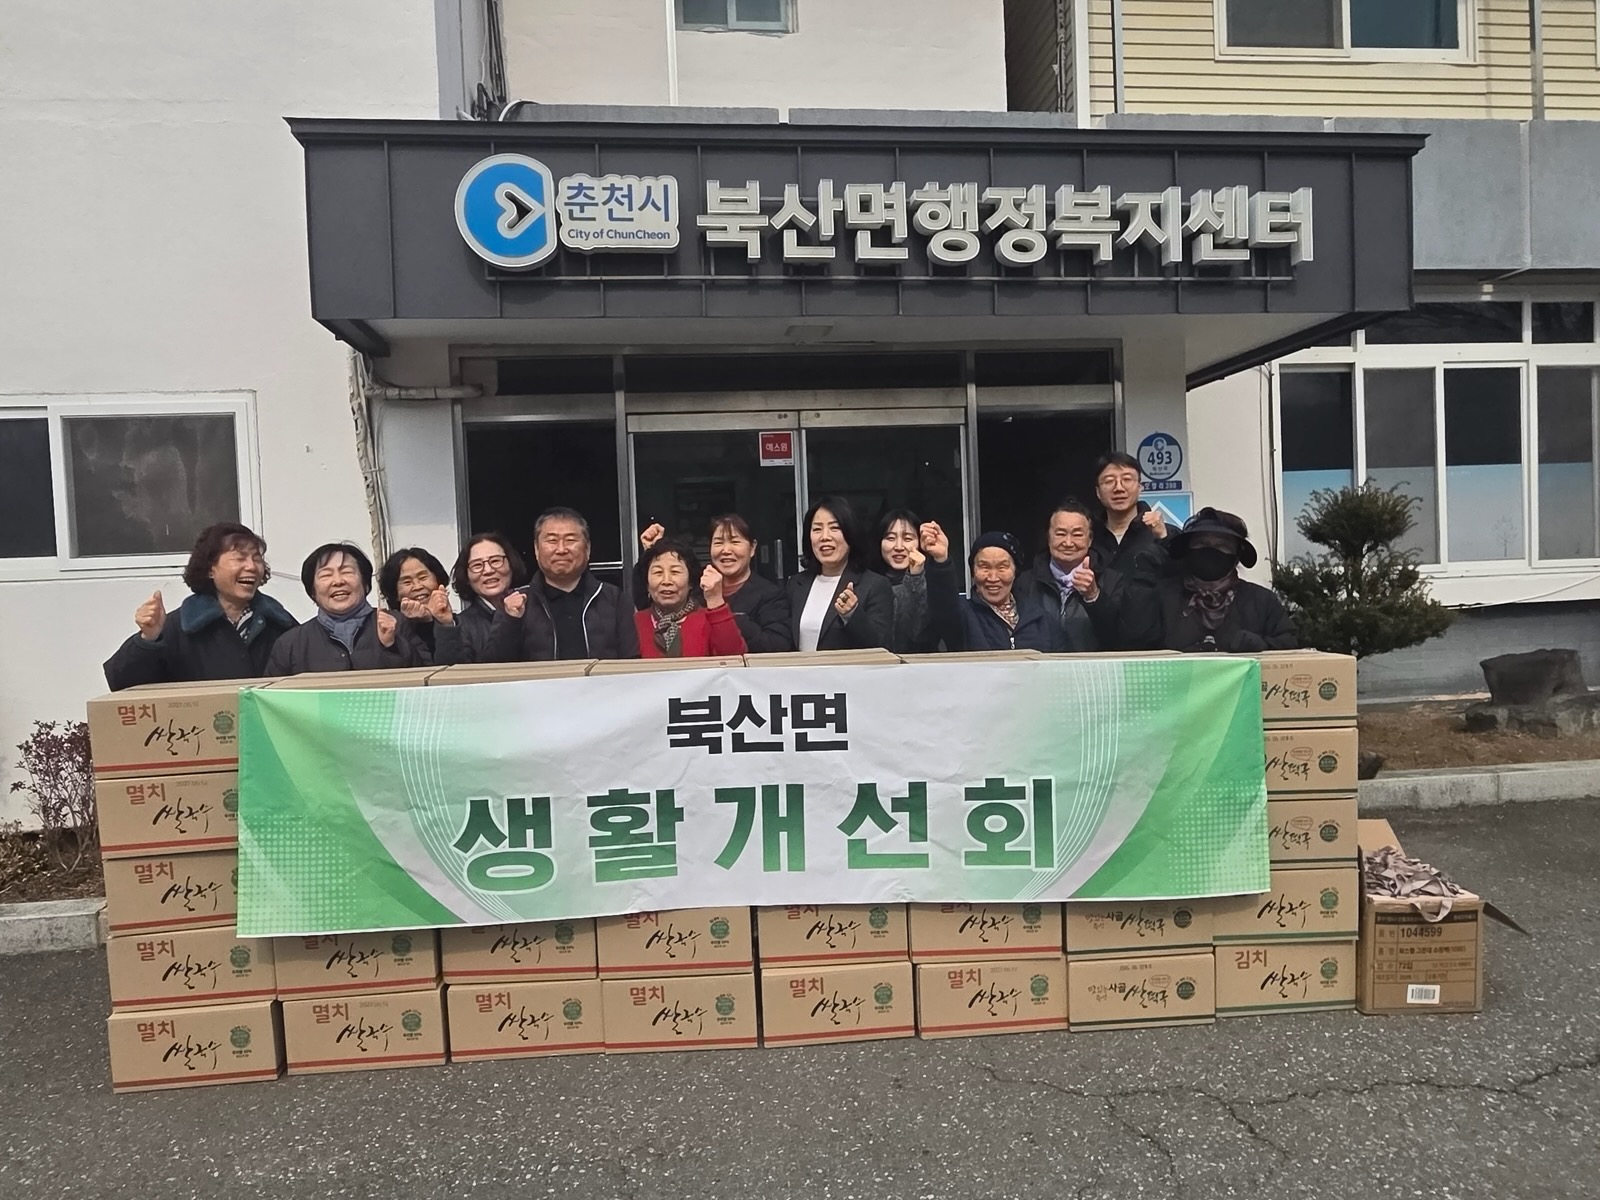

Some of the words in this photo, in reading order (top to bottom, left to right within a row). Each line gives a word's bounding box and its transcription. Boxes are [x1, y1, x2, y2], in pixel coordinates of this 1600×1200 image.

[564, 182, 669, 223] 춘천시
[567, 229, 592, 242] City
[592, 229, 605, 240] of
[606, 229, 671, 241] ChunCheon
[697, 179, 1313, 264] 북산면행정복지센터
[1147, 451, 1173, 465] 493
[117, 704, 157, 726] 멸치
[666, 692, 849, 754] 북산면
[144, 719, 205, 755] 쌀국수
[126, 783, 165, 805] 멸치
[152, 798, 214, 834] 쌀국수
[452, 777, 1055, 892] 생활개선회
[134, 861, 174, 884] 멸치
[161, 876, 223, 911] 쌀국수
[959, 908, 1014, 943] 쌀국수
[1257, 894, 1311, 928] 쌀국수
[491, 929, 547, 964] 쌀국수
[645, 923, 702, 959] 쌀국수
[806, 914, 861, 948] 쌀국수
[1400, 927, 1443, 938] 1044599
[137, 939, 175, 961] 멸치
[326, 943, 384, 977] 쌀국수
[1234, 949, 1267, 970] 김치
[162, 954, 222, 989] 쌀국수
[789, 977, 824, 999] 멸치
[948, 968, 982, 989] 멸치
[1260, 964, 1312, 999] 쌀국수
[475, 992, 512, 1013] 멸치
[630, 985, 665, 1006] 멸치
[811, 990, 866, 1025] 쌀국수
[968, 982, 1022, 1017] 쌀국수
[312, 1003, 349, 1024] 멸치
[498, 1006, 554, 1040] 쌀국수
[652, 1000, 708, 1035] 쌀국수
[137, 1020, 176, 1042] 멸치
[335, 1017, 394, 1052] 쌀국수
[162, 1035, 222, 1070] 쌀국수
